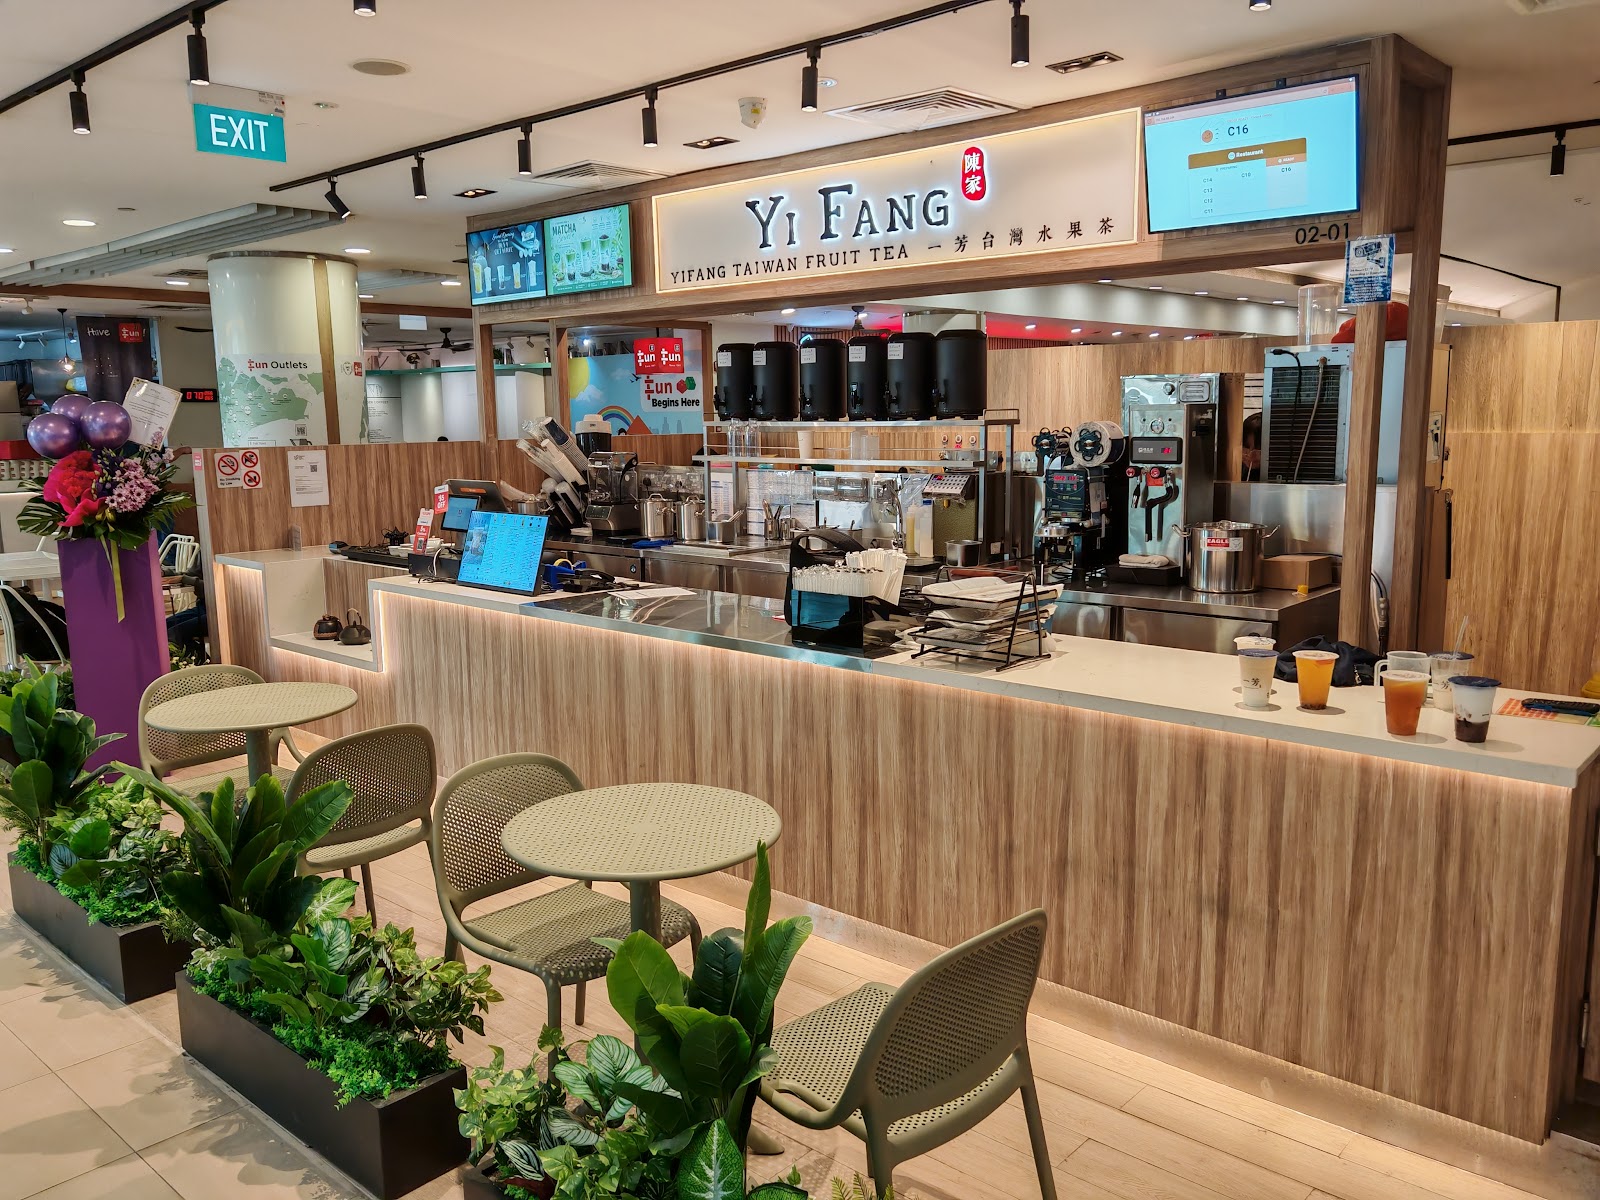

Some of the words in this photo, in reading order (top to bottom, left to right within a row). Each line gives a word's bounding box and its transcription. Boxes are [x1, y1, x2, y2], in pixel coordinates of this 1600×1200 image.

[209, 113, 269, 152] EXIT
[1227, 124, 1249, 136] C16
[1236, 149, 1264, 158] Restaurant
[964, 153, 983, 195] 陳家
[552, 222, 577, 236] MATCHA
[1295, 222, 1349, 245] 02-01
[670, 265, 727, 284] YIFANG
[732, 257, 798, 277] TAIWAN
[805, 249, 860, 269] FRUIT
[869, 244, 909, 262] TEA
[87, 327, 111, 337] Have
[270, 361, 308, 369] Outlets
[652, 398, 679, 408] Begins
[681, 398, 700, 406] Here
